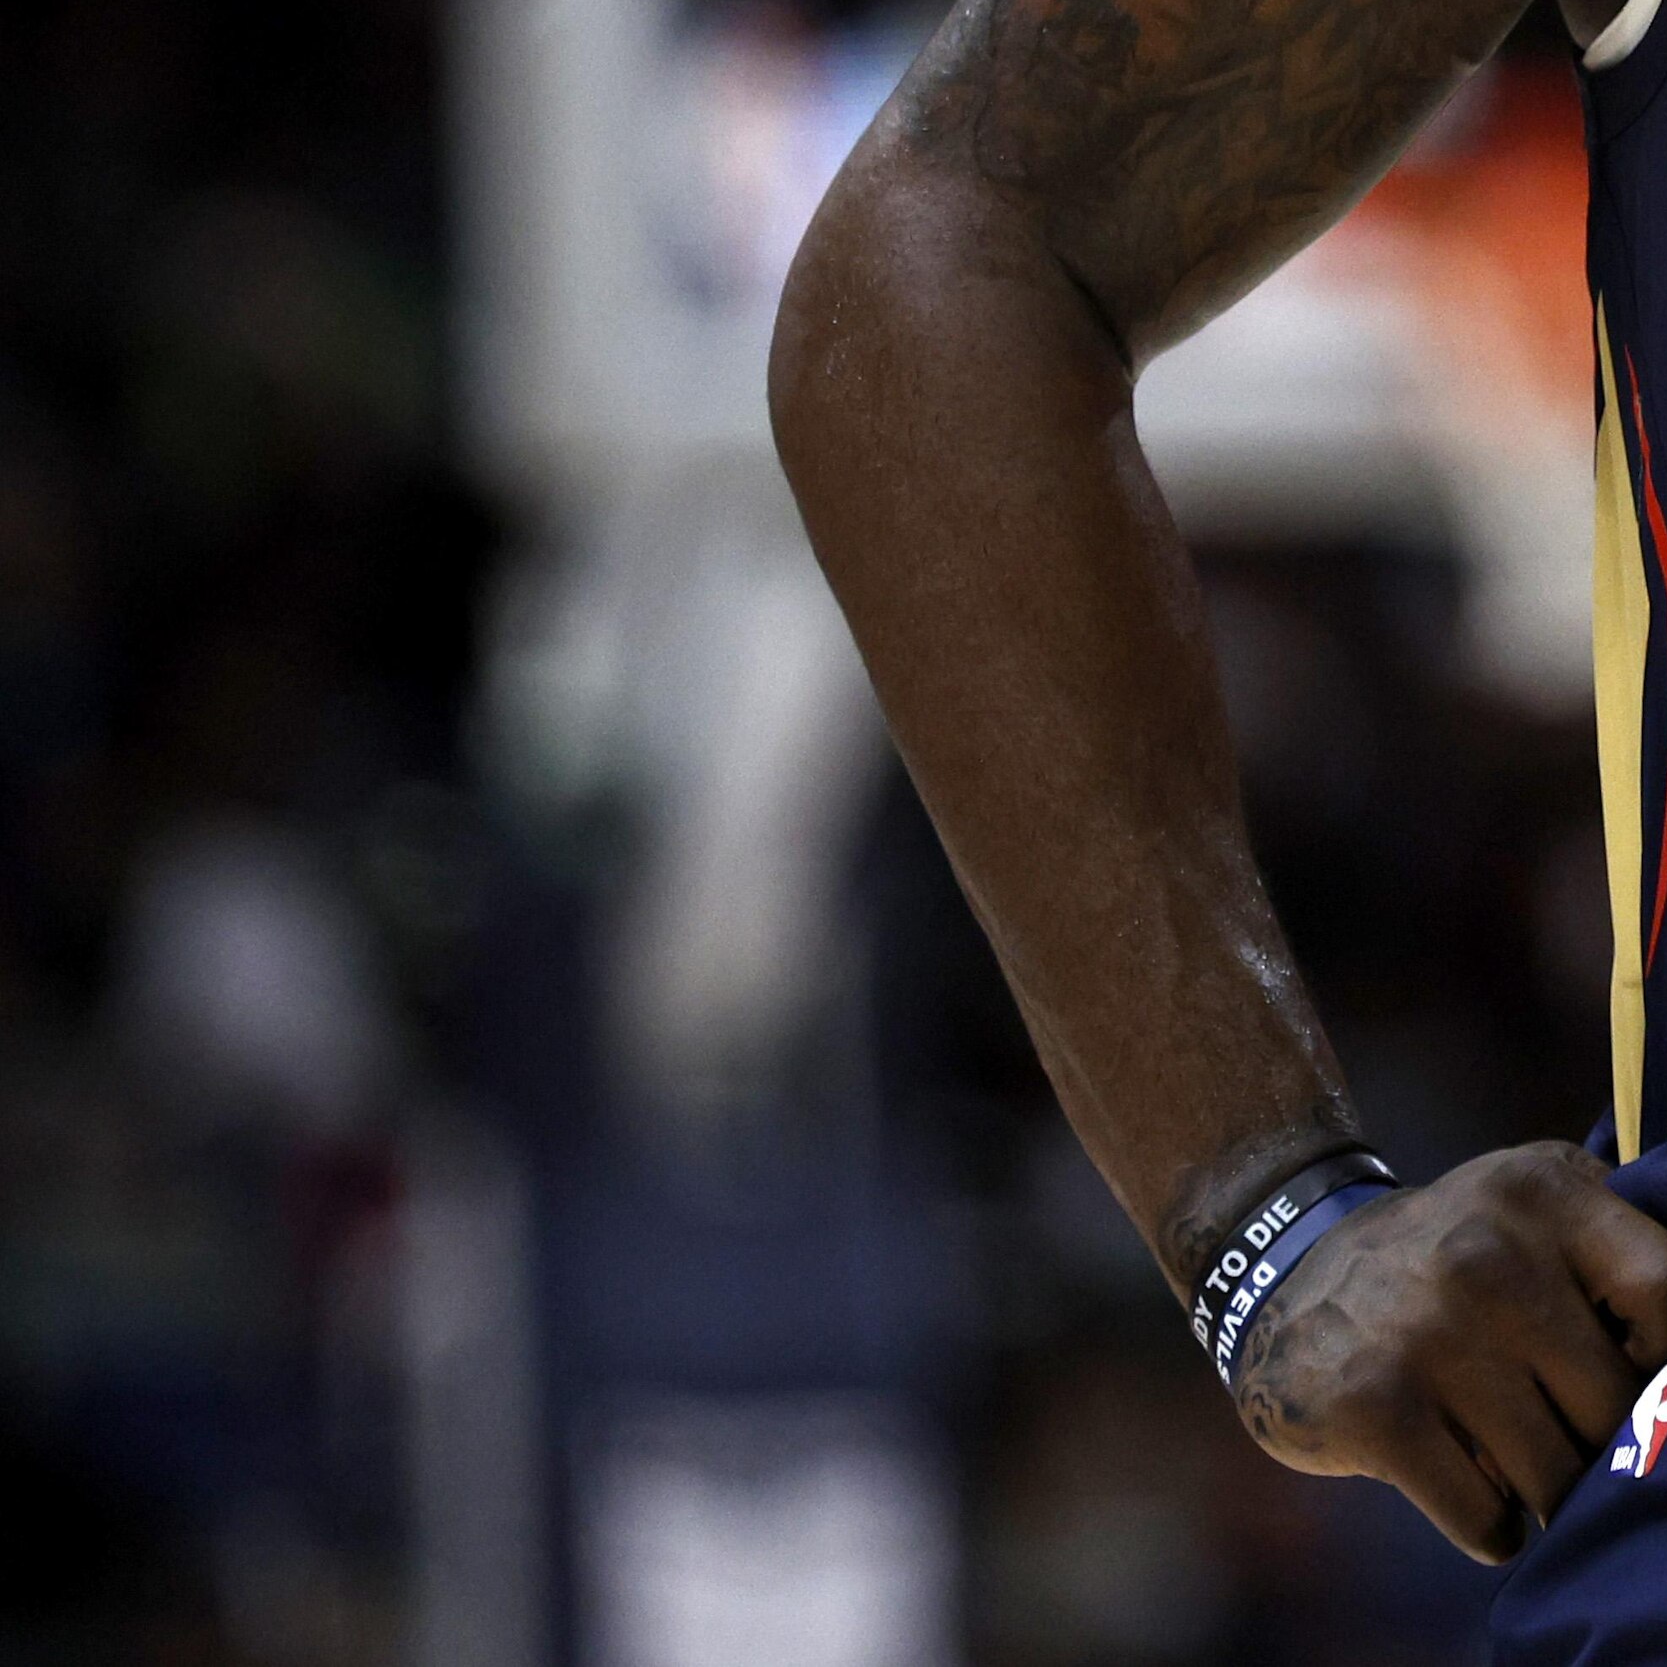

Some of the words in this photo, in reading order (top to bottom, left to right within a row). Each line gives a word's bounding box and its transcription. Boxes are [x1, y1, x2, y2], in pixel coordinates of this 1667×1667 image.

[1205, 1249, 1249, 1293] TO
[1243, 1194, 1300, 1251] DIE
[1610, 1444, 1638, 1472] NBA
